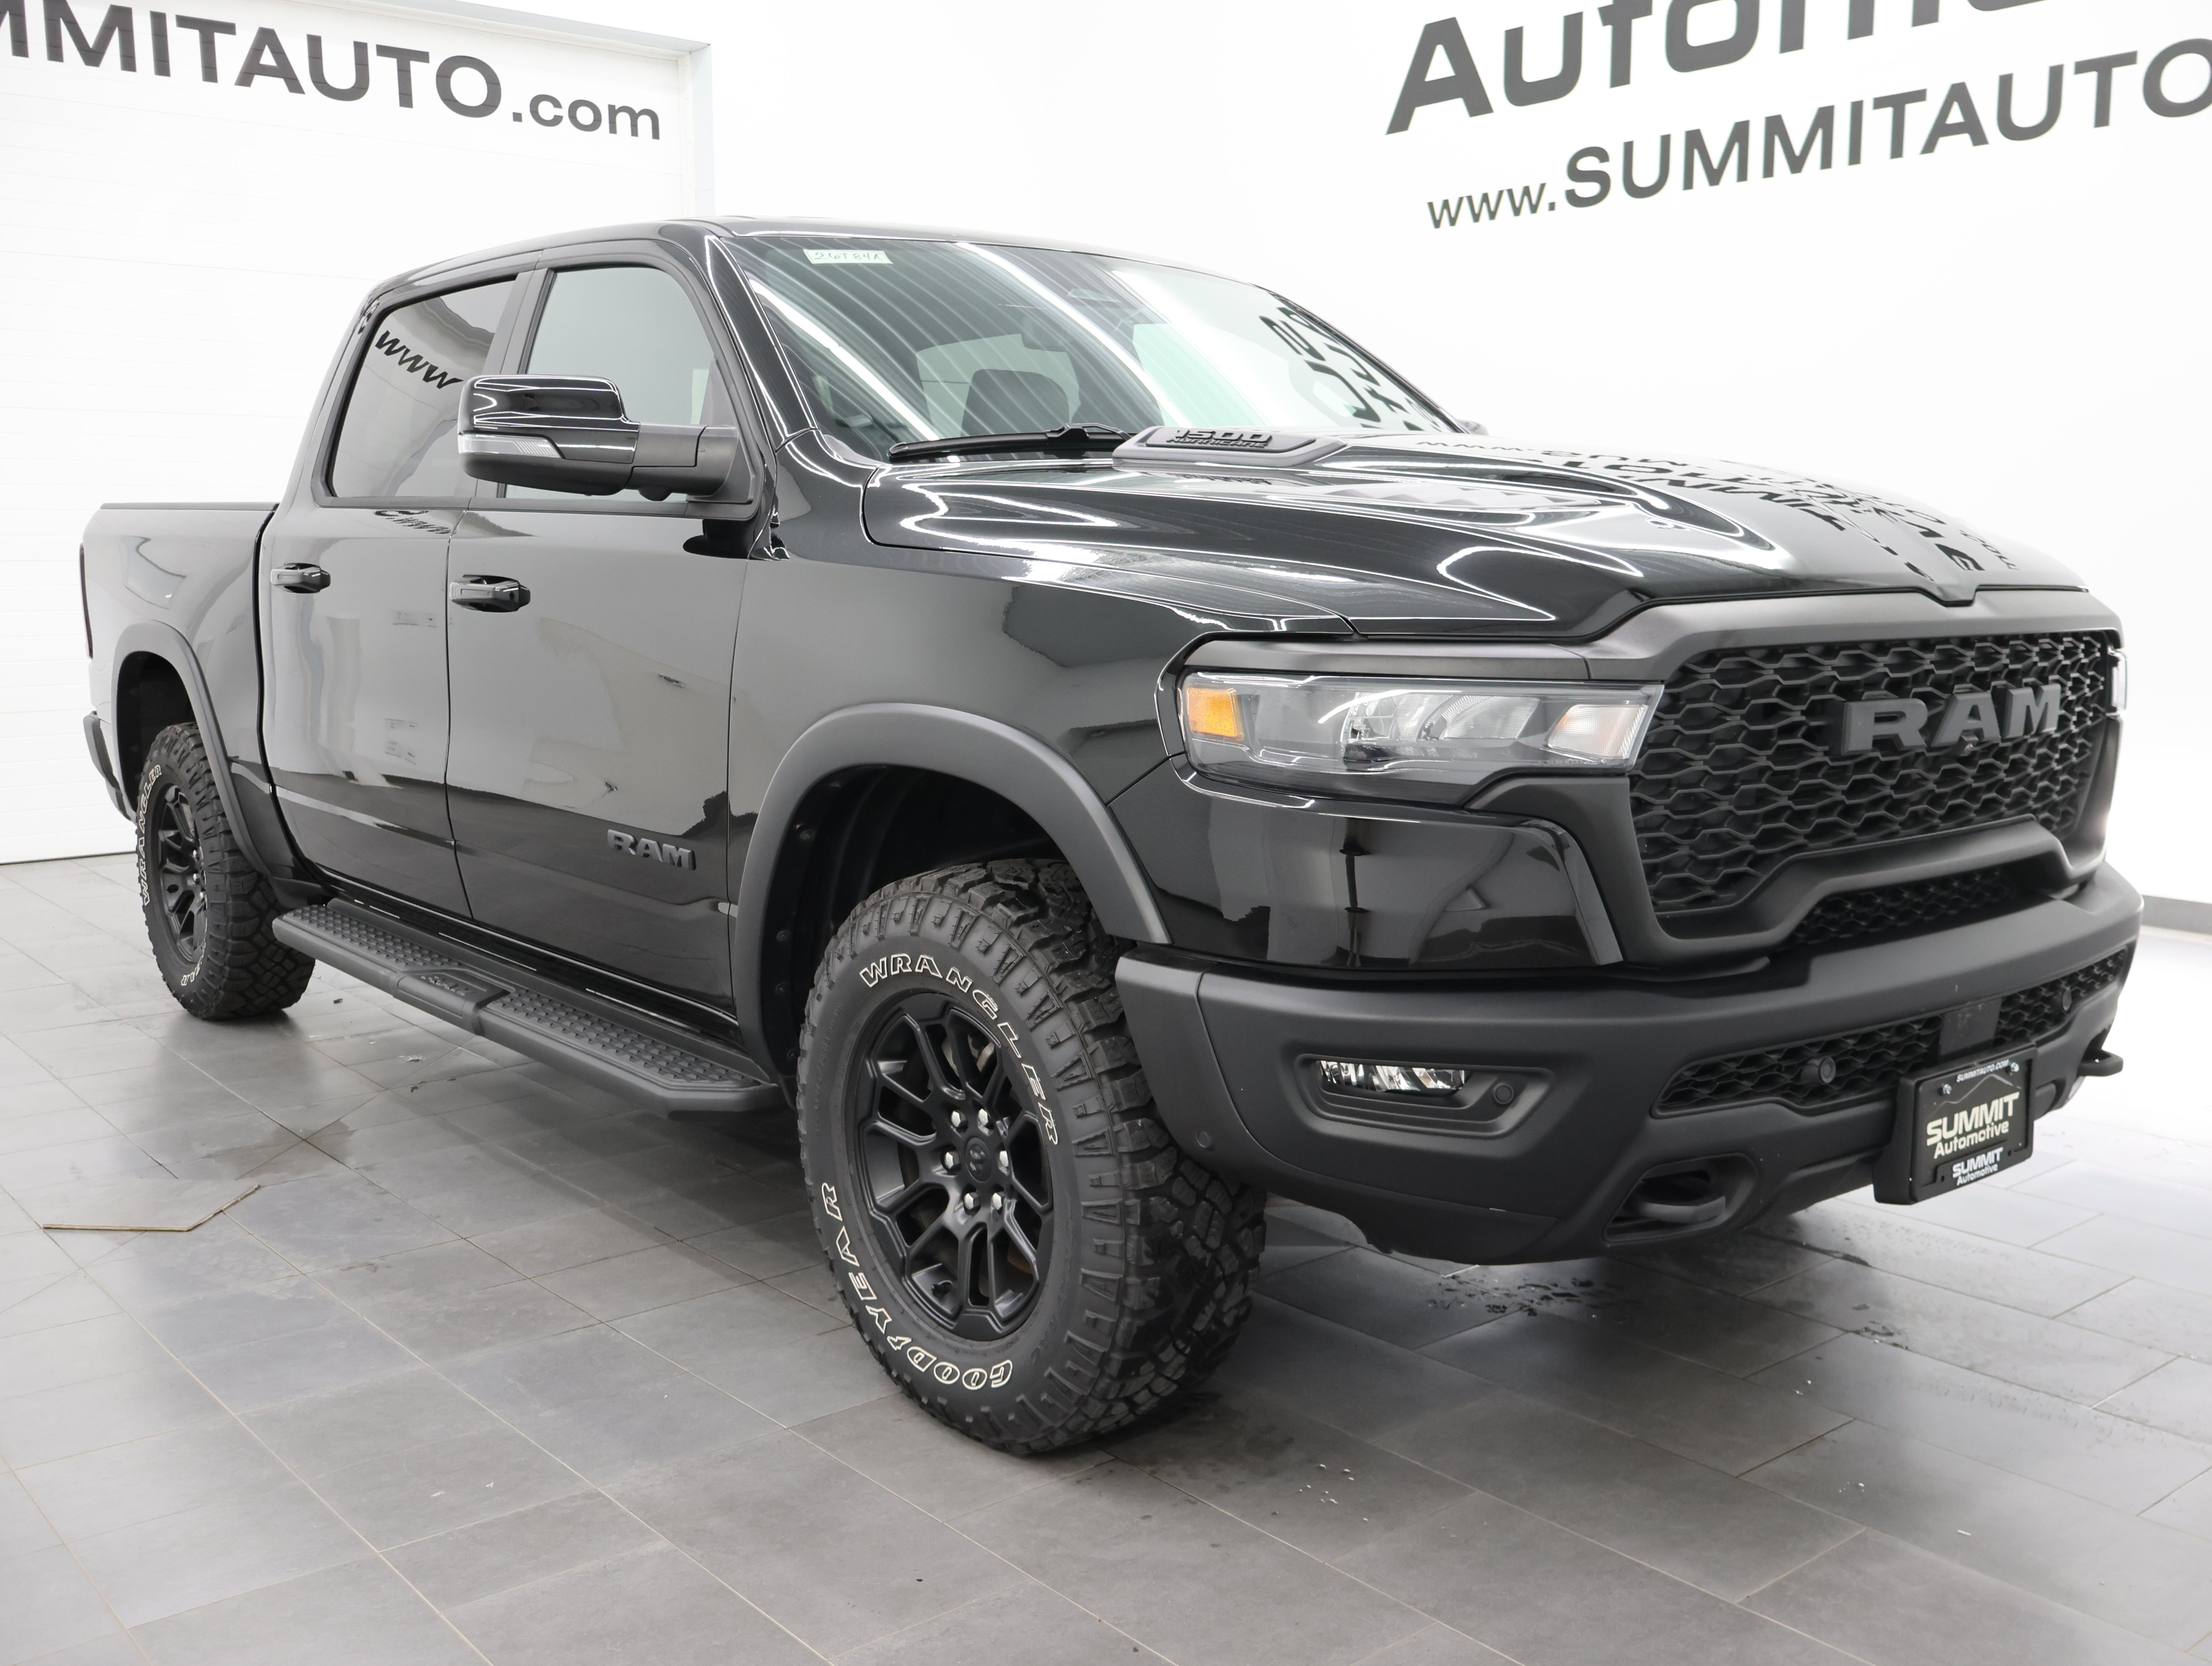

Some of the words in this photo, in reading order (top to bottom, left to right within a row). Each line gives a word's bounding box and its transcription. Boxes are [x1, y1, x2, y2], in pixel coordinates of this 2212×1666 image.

[1386, 0, 2044, 135] Auto
[1427, 39, 2212, 229] www.SUMMITAUTO
[1175, 429, 1272, 442] 1500
[1841, 683, 2061, 755] RAM
[137, 764, 162, 906] WRANGLER
[607, 829, 696, 870] RAM
[860, 954, 1058, 1145] WRANGLER
[1956, 1059, 2010, 1083] SUMMITAUTO.COM
[1927, 1091, 2020, 1146] SUMMIT
[1934, 1121, 2010, 1159] Automotive
[1952, 1147, 2004, 1178] SUMMIT
[1956, 1164, 1998, 1186] Automotive
[821, 1182, 1014, 1390] GOODYEAR
